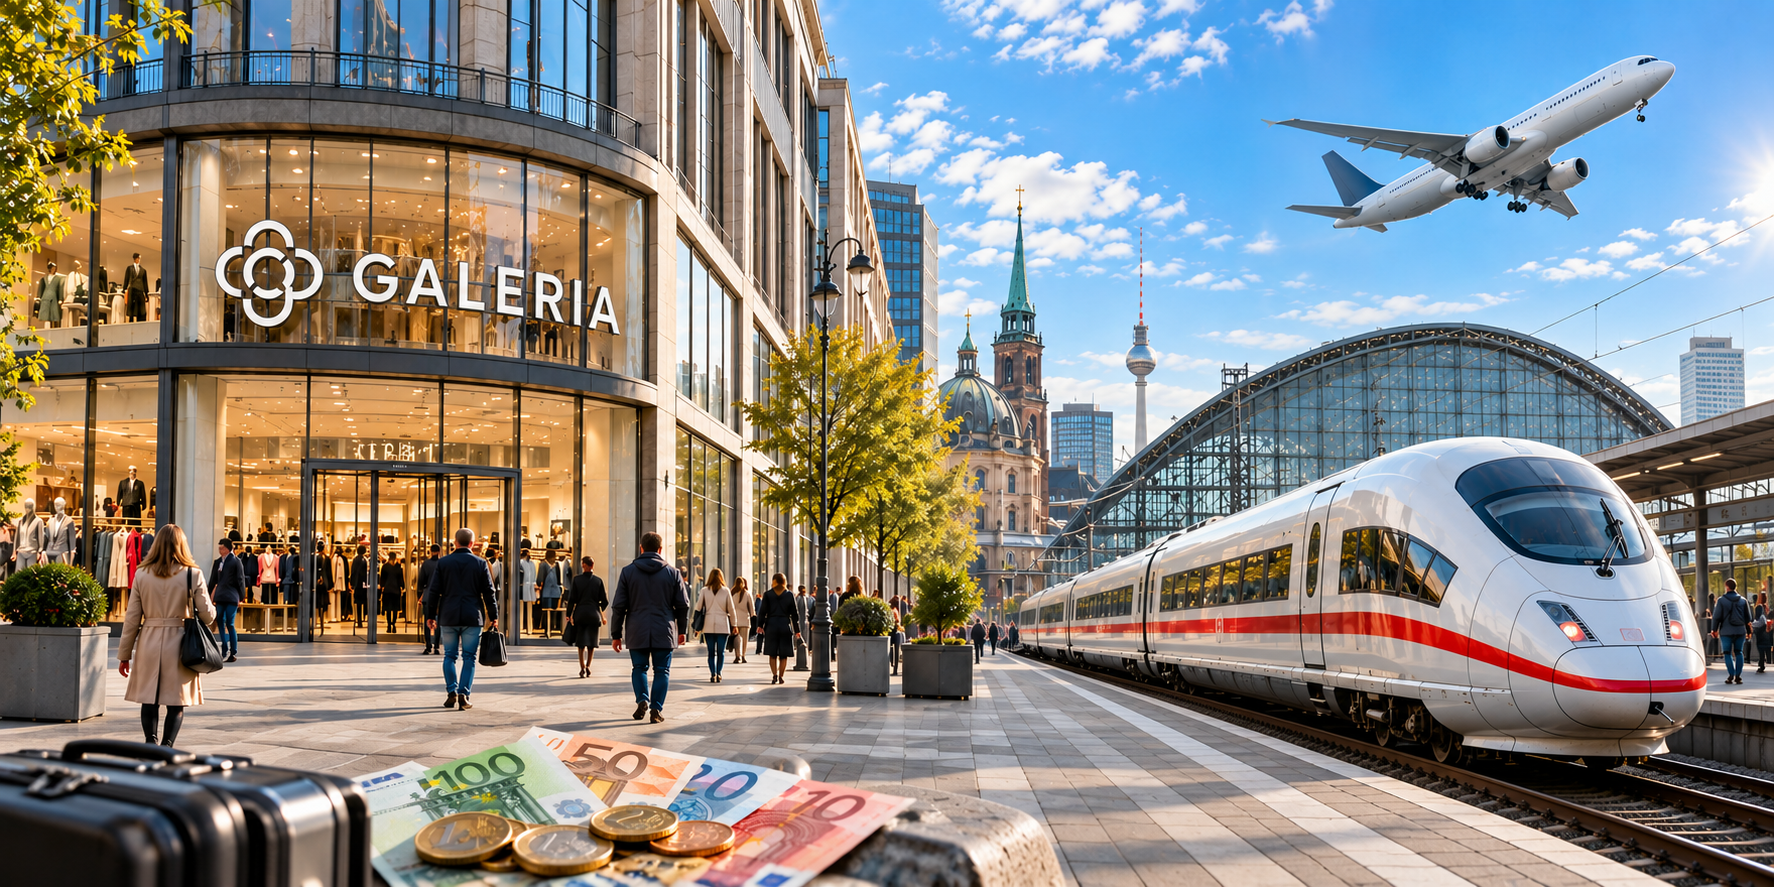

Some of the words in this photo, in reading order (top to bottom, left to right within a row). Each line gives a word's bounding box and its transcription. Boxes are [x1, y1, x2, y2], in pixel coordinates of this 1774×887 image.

[352, 253, 620, 336] GALERIA
[433, 752, 526, 791] 100
[568, 743, 648, 780] 50
[791, 790, 866, 821] 10
